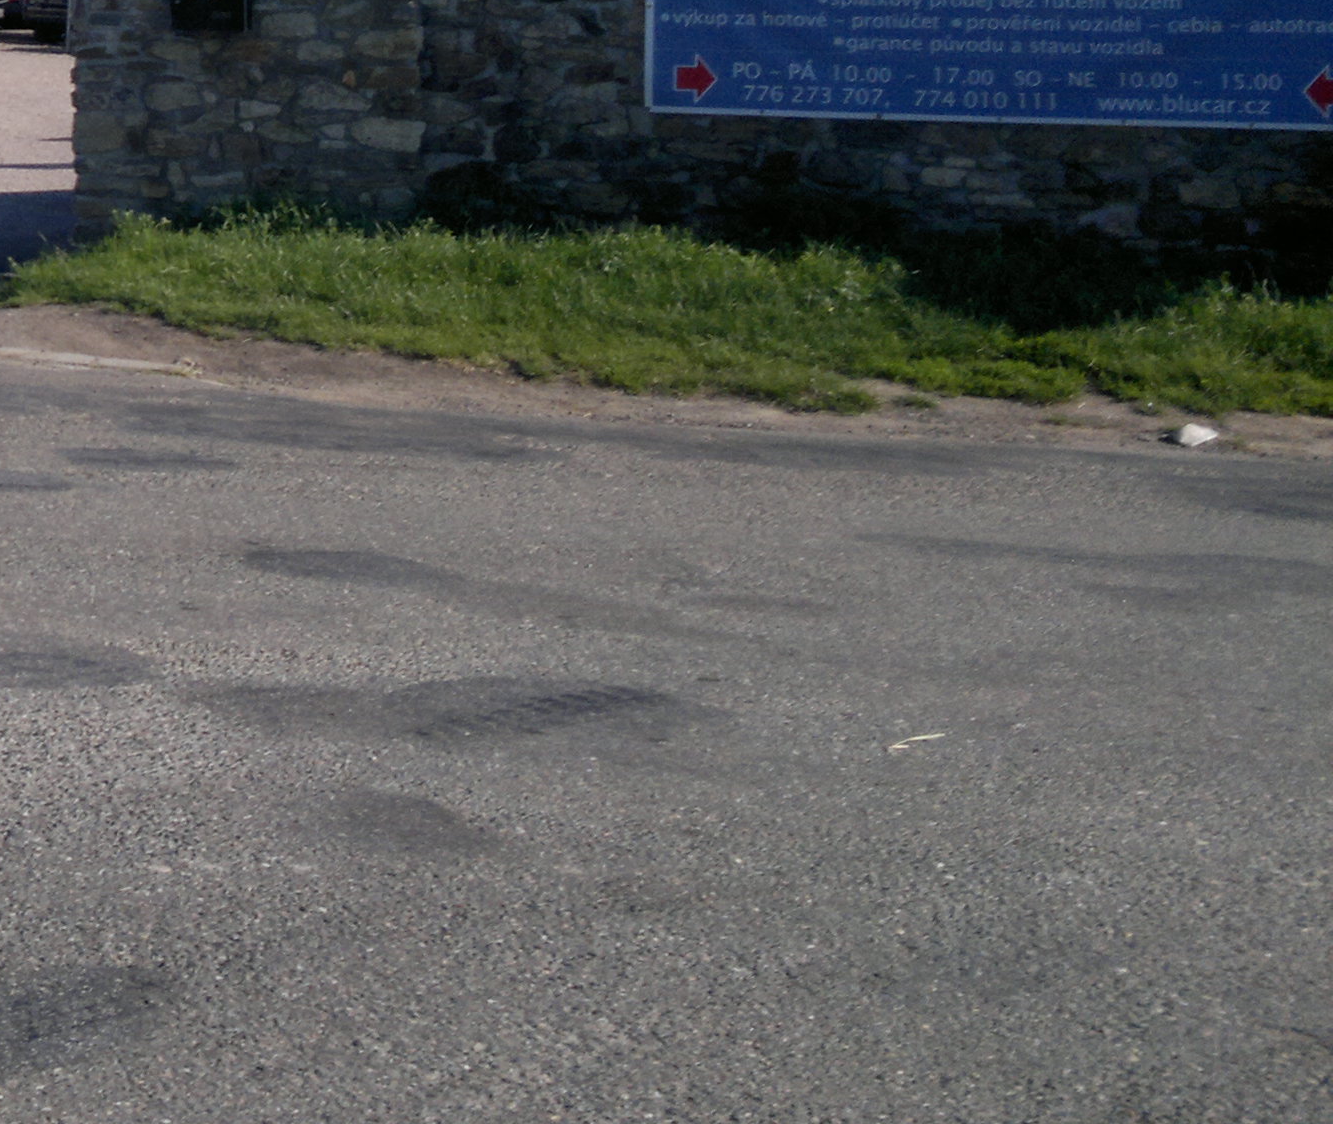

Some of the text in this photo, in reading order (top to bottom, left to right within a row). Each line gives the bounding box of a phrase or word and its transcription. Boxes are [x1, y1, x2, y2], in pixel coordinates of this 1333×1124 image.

[734, 14, 757, 26] za
[846, 38, 923, 52] garance
[1011, 41, 1022, 52] a
[1029, 39, 1083, 54] stavu
[1089, 39, 1164, 55] vozidla
[734, 62, 761, 79] PO
[788, 59, 818, 80] PÁ
[833, 65, 892, 83] 10.00
[934, 67, 994, 85] 17.00
[1014, 69, 1042, 87] SO
[1068, 71, 1097, 88] NE
[1119, 72, 1178, 89] 10.00
[1221, 73, 1283, 91] 15.00
[744, 85, 783, 102] 776
[791, 86, 831, 103] 273
[915, 89, 957, 107] 774
[963, 90, 1008, 109] 010
[1018, 92, 1057, 110] 111
[1097, 95, 1272, 116] www.blucar.cz
